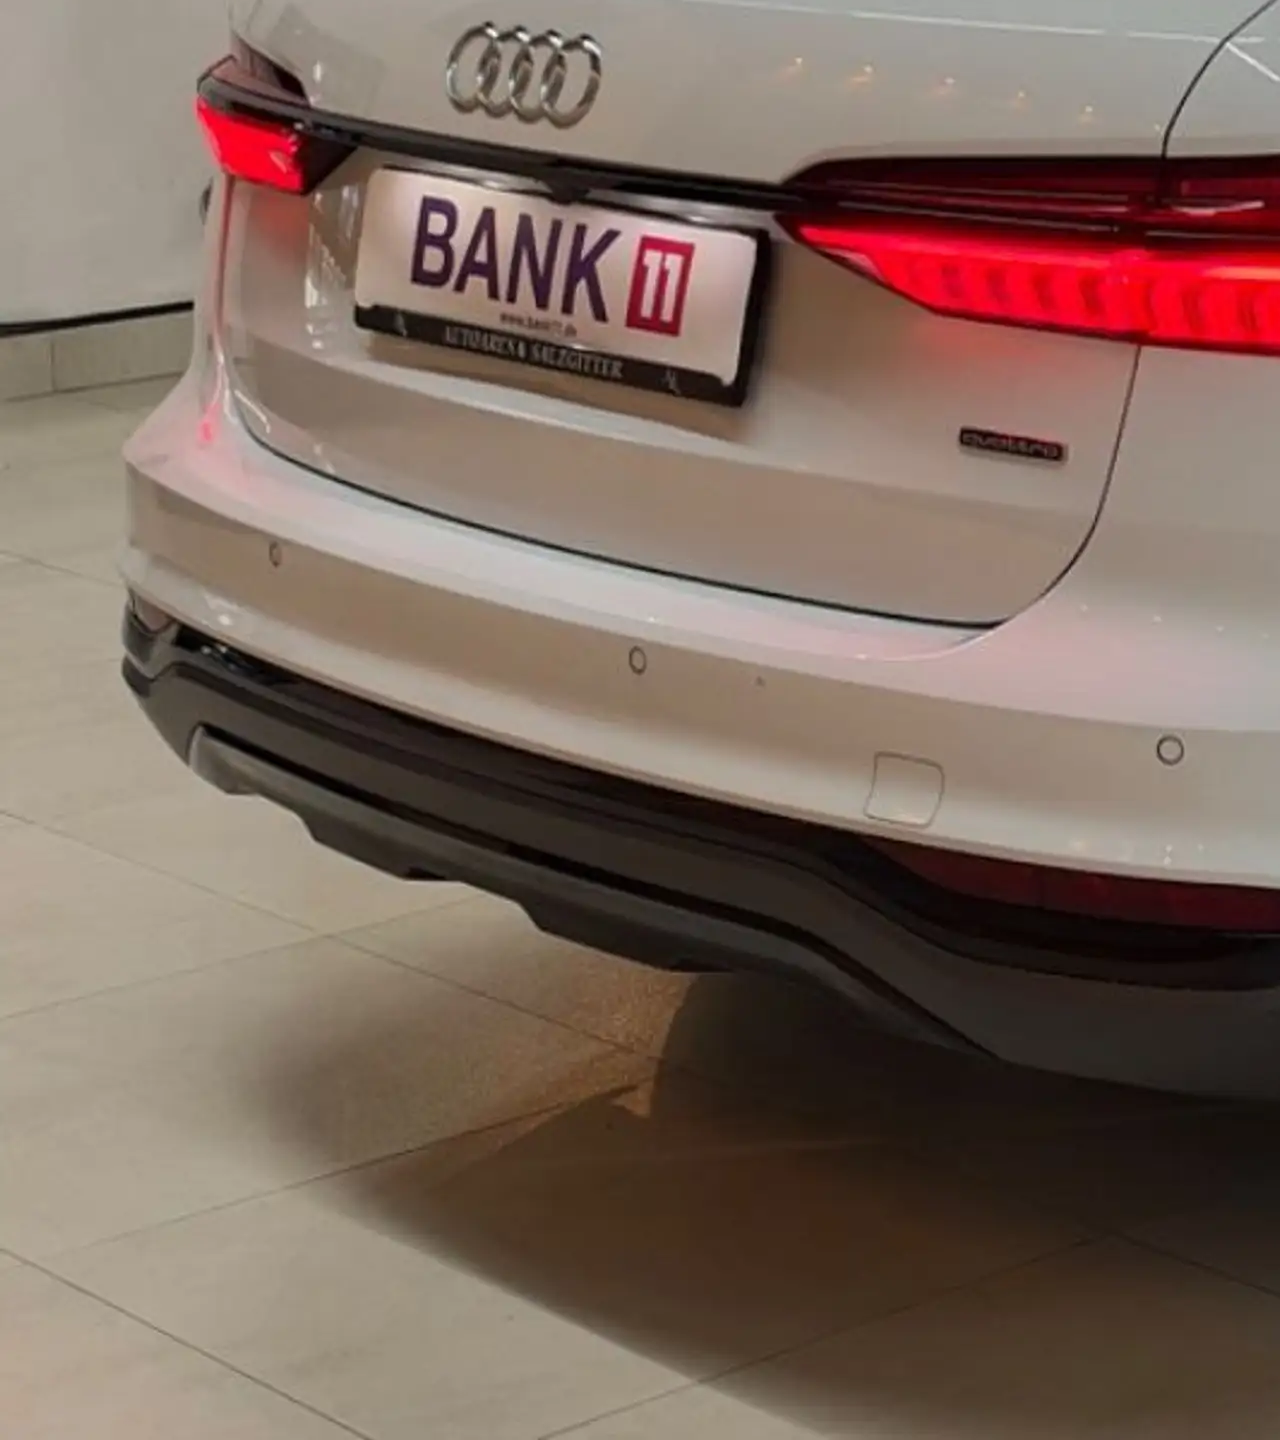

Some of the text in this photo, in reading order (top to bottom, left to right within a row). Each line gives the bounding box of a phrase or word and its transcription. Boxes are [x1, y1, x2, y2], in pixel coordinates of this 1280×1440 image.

[411, 196, 687, 326] BANK 11
[531, 343, 624, 379] SALZGITTER
